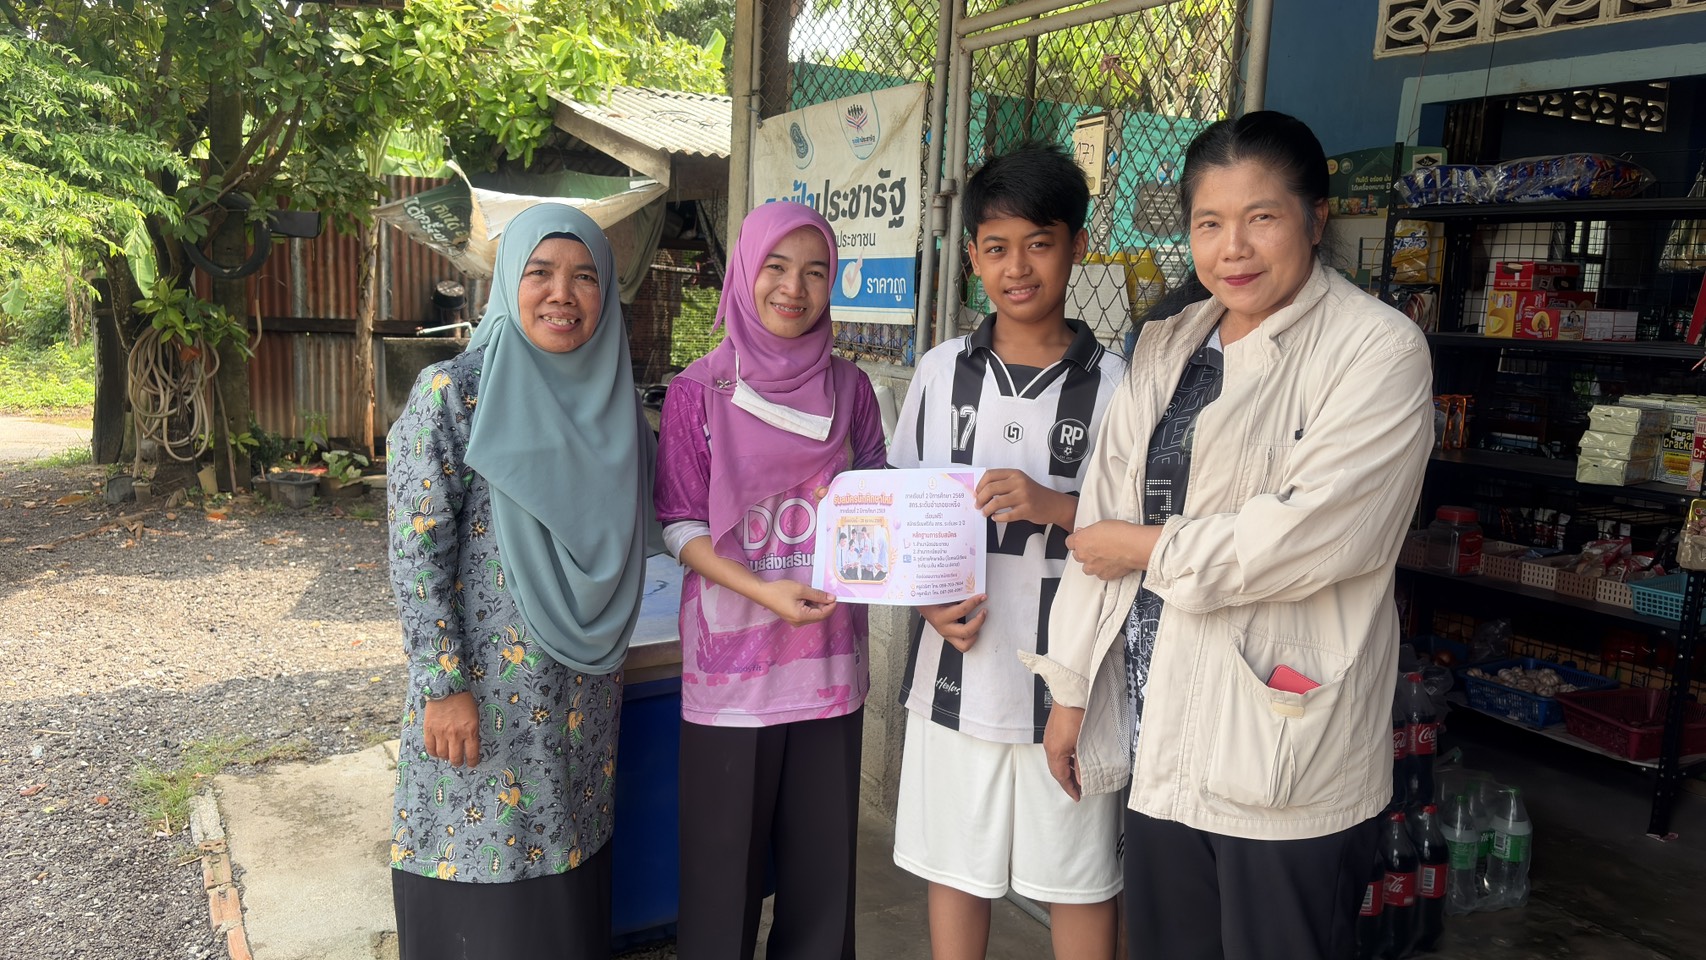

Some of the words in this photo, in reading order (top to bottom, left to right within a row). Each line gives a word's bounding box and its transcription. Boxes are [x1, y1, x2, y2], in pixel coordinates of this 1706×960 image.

[866, 277, 907, 302] ราคาถูก
[1059, 423, 1084, 446] RP
